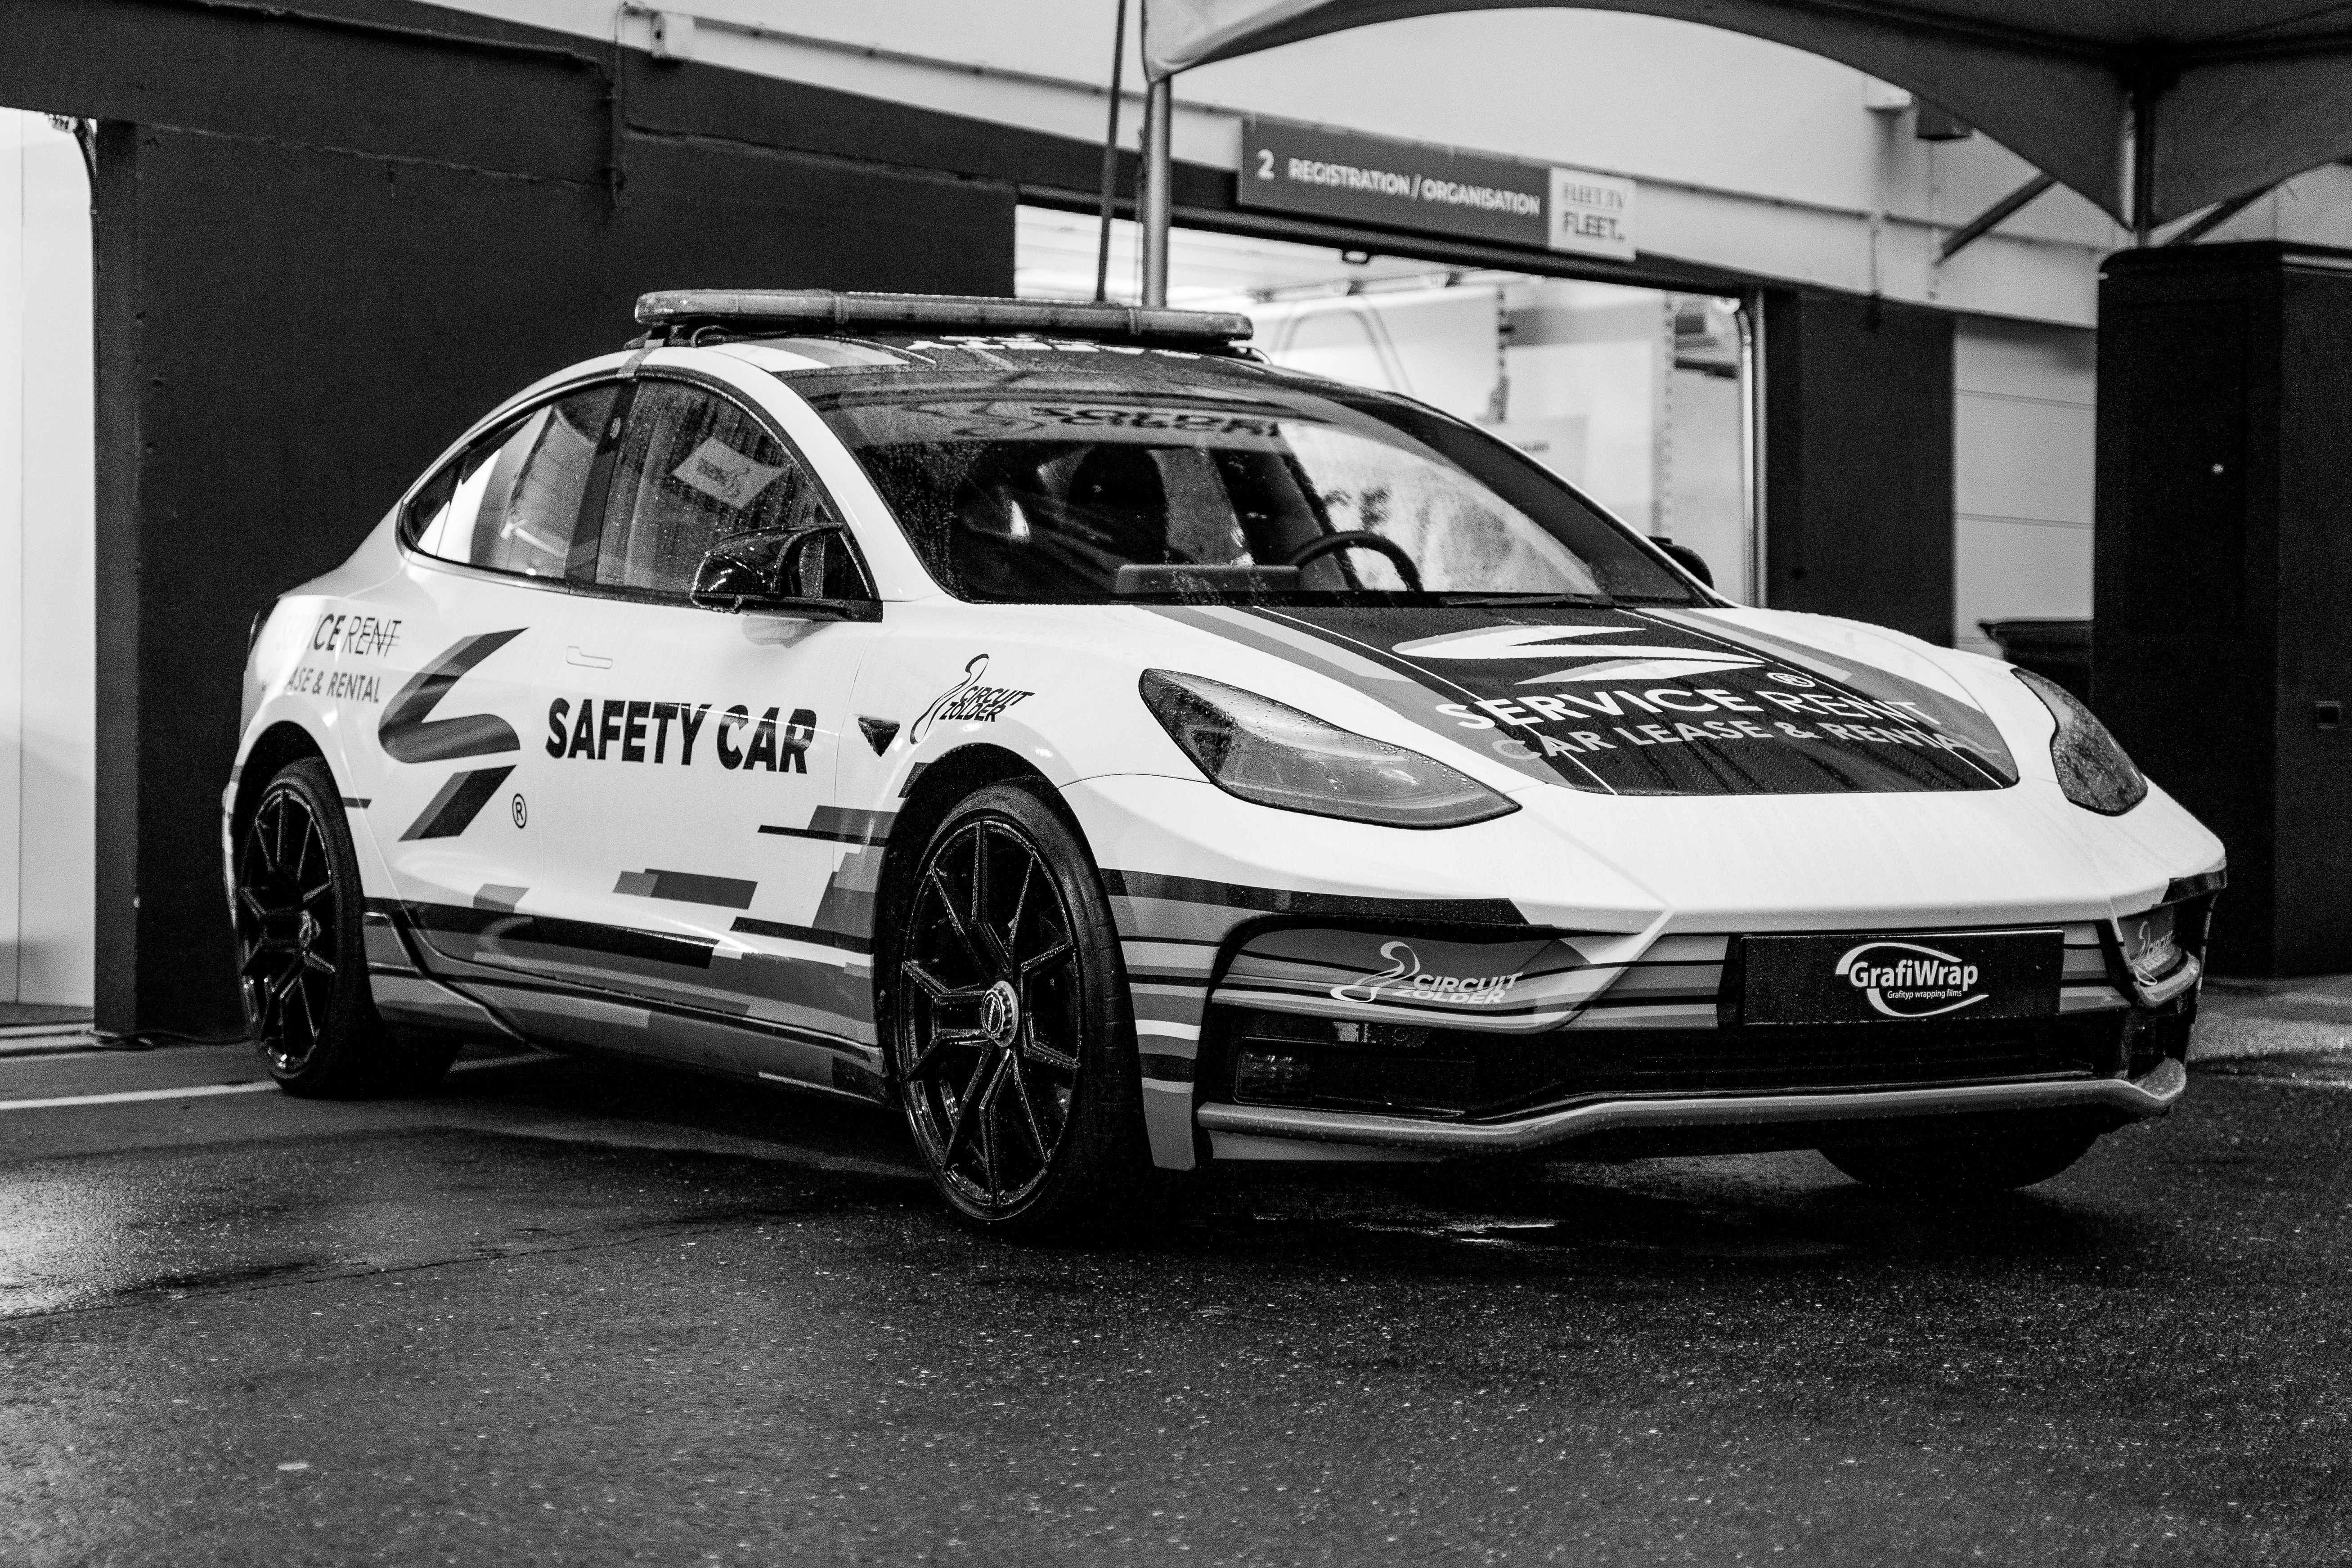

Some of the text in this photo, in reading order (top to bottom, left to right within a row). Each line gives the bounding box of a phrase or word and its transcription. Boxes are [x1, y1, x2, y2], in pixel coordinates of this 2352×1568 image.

[1257, 149, 1275, 179] 2
[310, 670, 326, 696] &
[325, 670, 381, 704] RENTAL
[960, 686, 1036, 706] CIRCUIT
[938, 701, 1006, 722] ZOLDER
[1435, 688, 1941, 729] SERVICE RENT
[545, 697, 817, 774] SAFETY CAR
[1491, 720, 2001, 760] CAR LEASE & RENTAL
[1414, 972, 1524, 993] CIRCUIT
[1850, 959, 1979, 992] GrafiWrap
[1391, 985, 1506, 1005] ZOLDER
[1887, 991, 1914, 1000] Grafityp
[1915, 991, 1945, 999] wrapping
